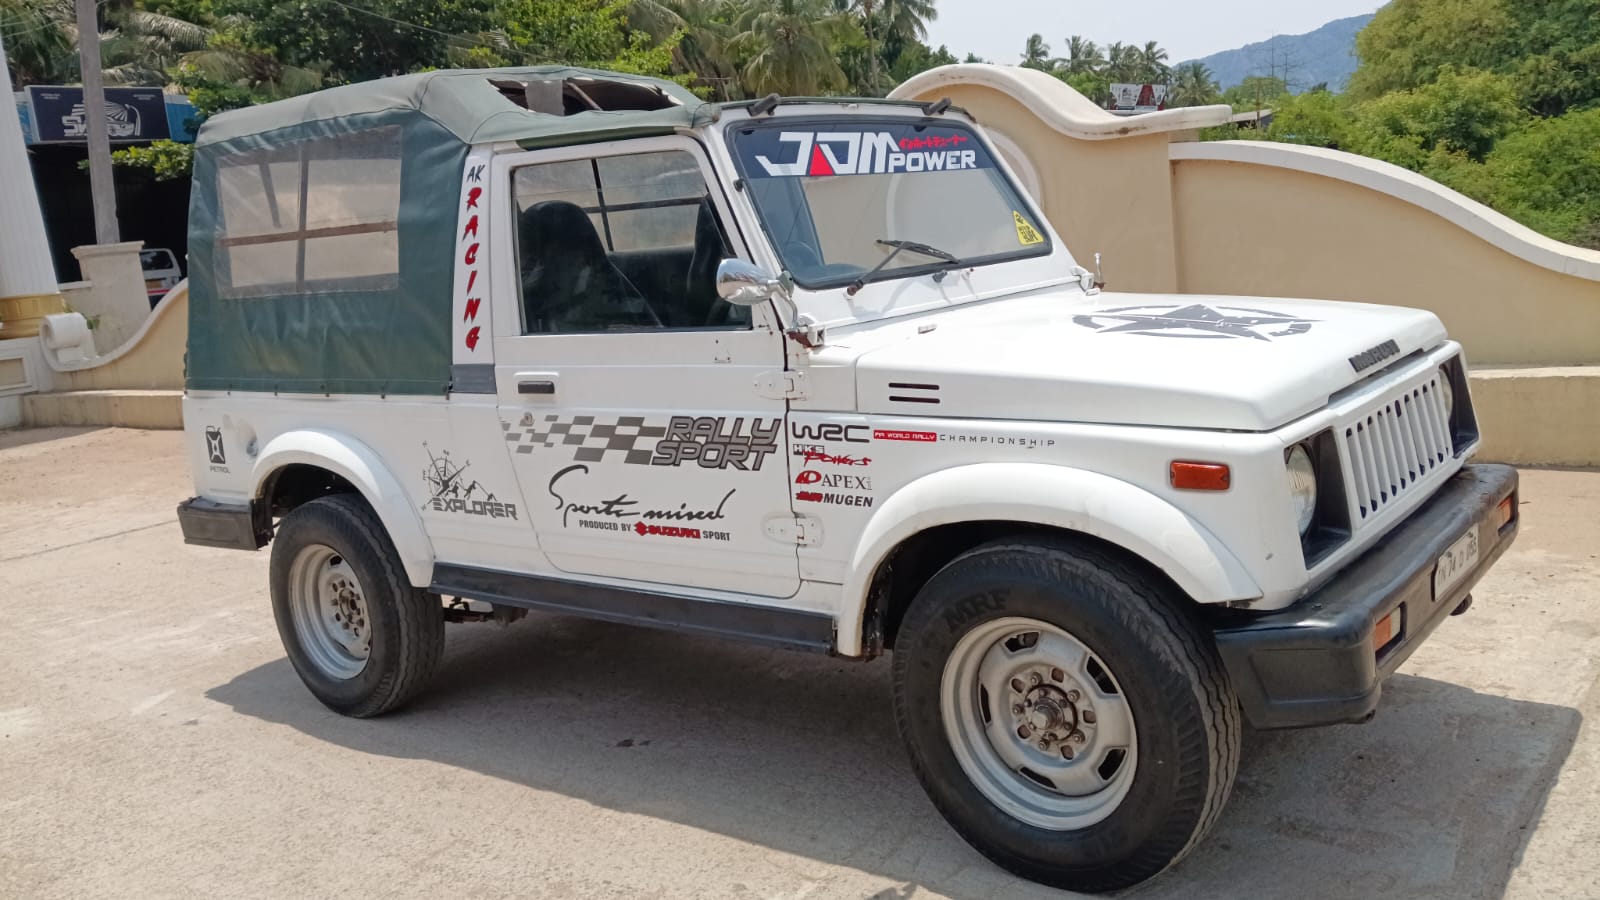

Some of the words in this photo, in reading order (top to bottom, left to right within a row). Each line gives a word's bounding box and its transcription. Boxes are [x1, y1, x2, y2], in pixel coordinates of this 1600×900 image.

[755, 131, 900, 177] JDM
[888, 149, 977, 173] POWER
[466, 164, 485, 183] AK
[462, 186, 483, 352] RACING
[664, 415, 782, 444] RALLY
[792, 421, 870, 443] WRC
[939, 433, 1056, 447] CHAMPIONSHIP
[651, 440, 778, 471] SPORT
[793, 444, 824, 456] HKS
[209, 465, 231, 474] PETROL
[432, 497, 518, 520] EXPLORER
[823, 493, 873, 507] MUGEN
[578, 519, 618, 531] PRODUCED
[621, 523, 631, 532] BY
[702, 530, 731, 542] SPORT
